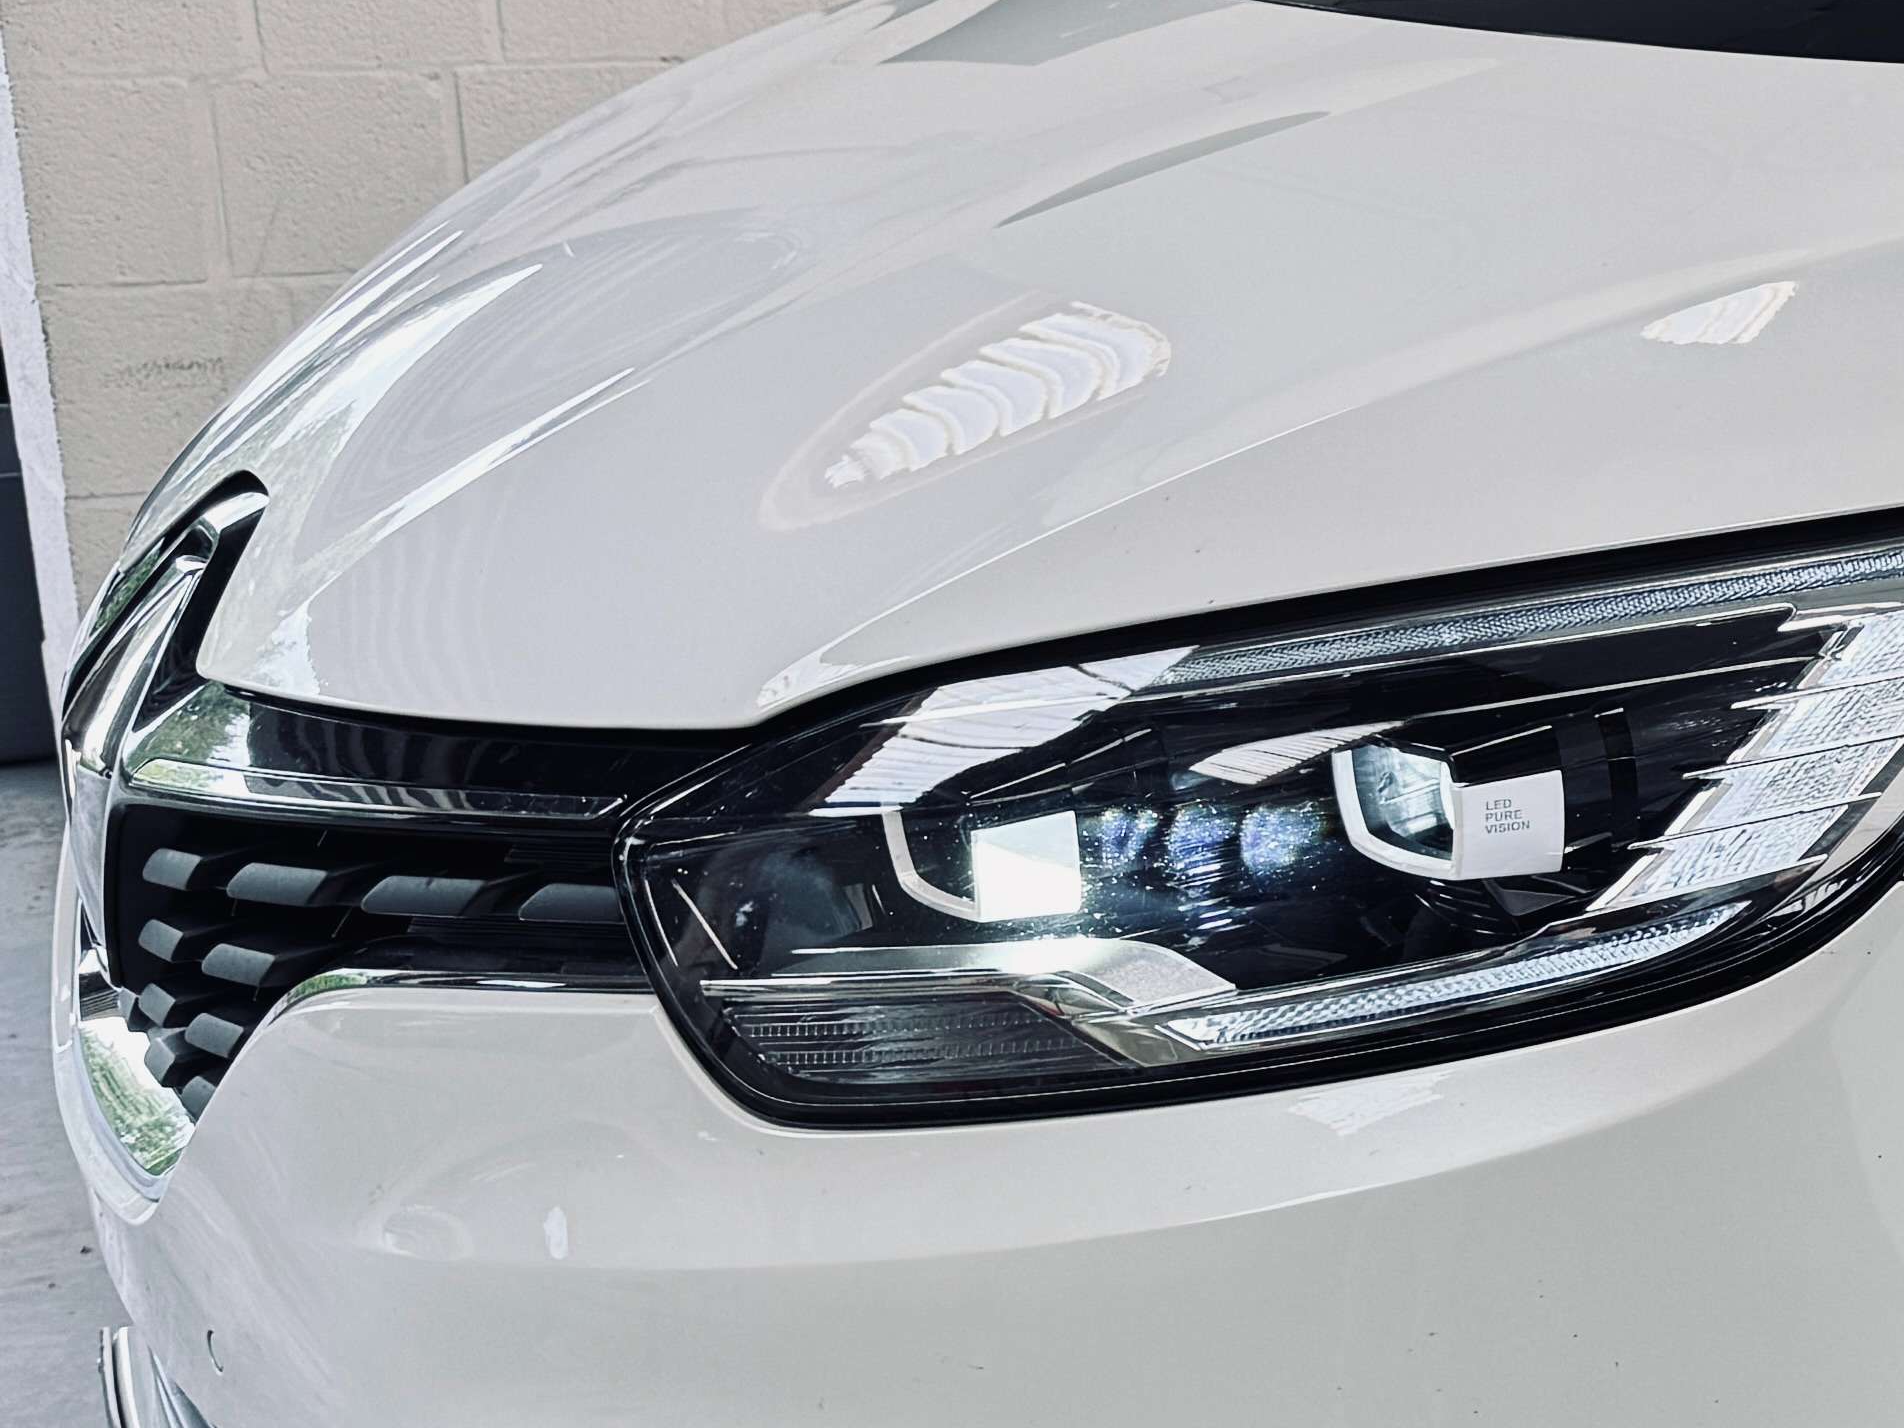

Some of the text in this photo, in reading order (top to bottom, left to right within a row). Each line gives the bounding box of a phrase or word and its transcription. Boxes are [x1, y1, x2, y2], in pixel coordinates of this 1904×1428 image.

[1486, 799, 1512, 811] LED
[1485, 809, 1523, 822] PURE
[1485, 820, 1530, 834] VISION
